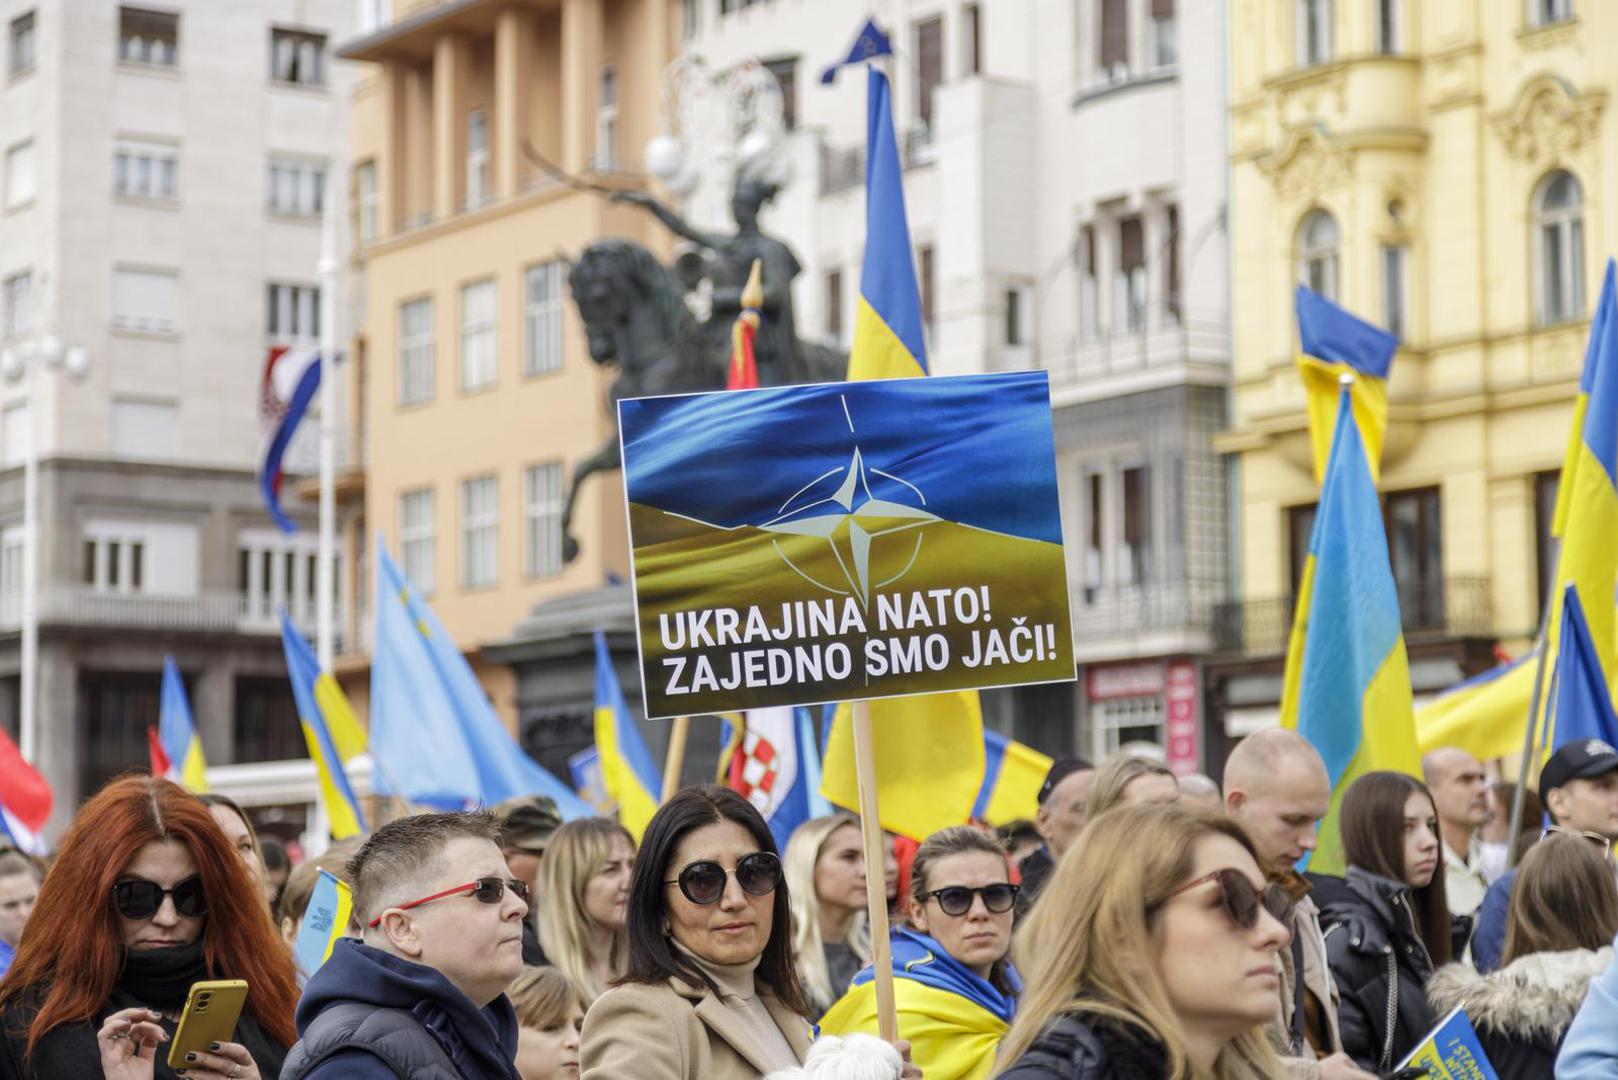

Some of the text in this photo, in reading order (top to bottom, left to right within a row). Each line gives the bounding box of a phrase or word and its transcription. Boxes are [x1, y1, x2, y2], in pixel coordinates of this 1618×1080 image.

[659, 585, 992, 650] UKRAJINA NATO!
[662, 616, 1057, 695] ZAJEDNO SMO JAČI!
[1448, 1037, 1460, 1047] I
